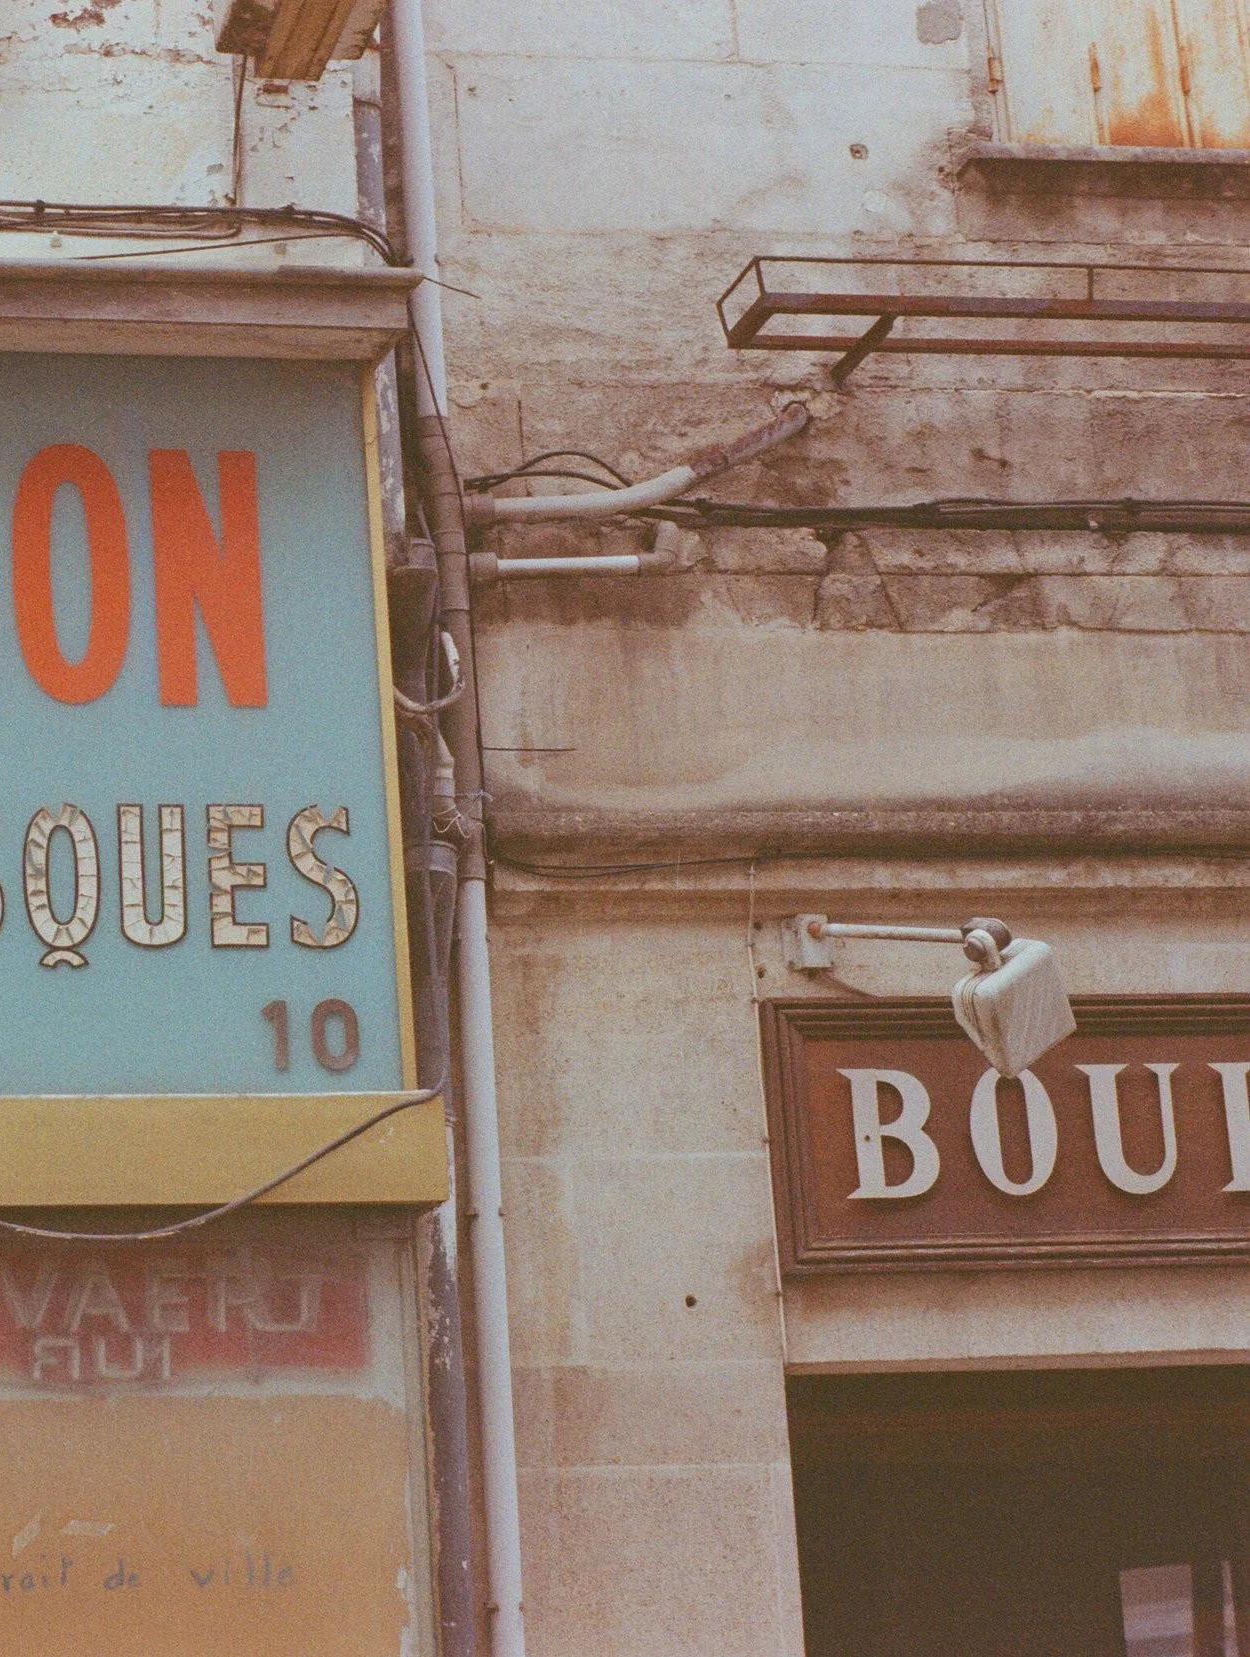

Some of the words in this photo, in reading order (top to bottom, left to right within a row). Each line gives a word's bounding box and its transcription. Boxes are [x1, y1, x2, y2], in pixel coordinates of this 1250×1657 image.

[260, 997, 362, 1075] 10
[103, 1557, 141, 1593] de
[189, 1549, 296, 1591] ville
